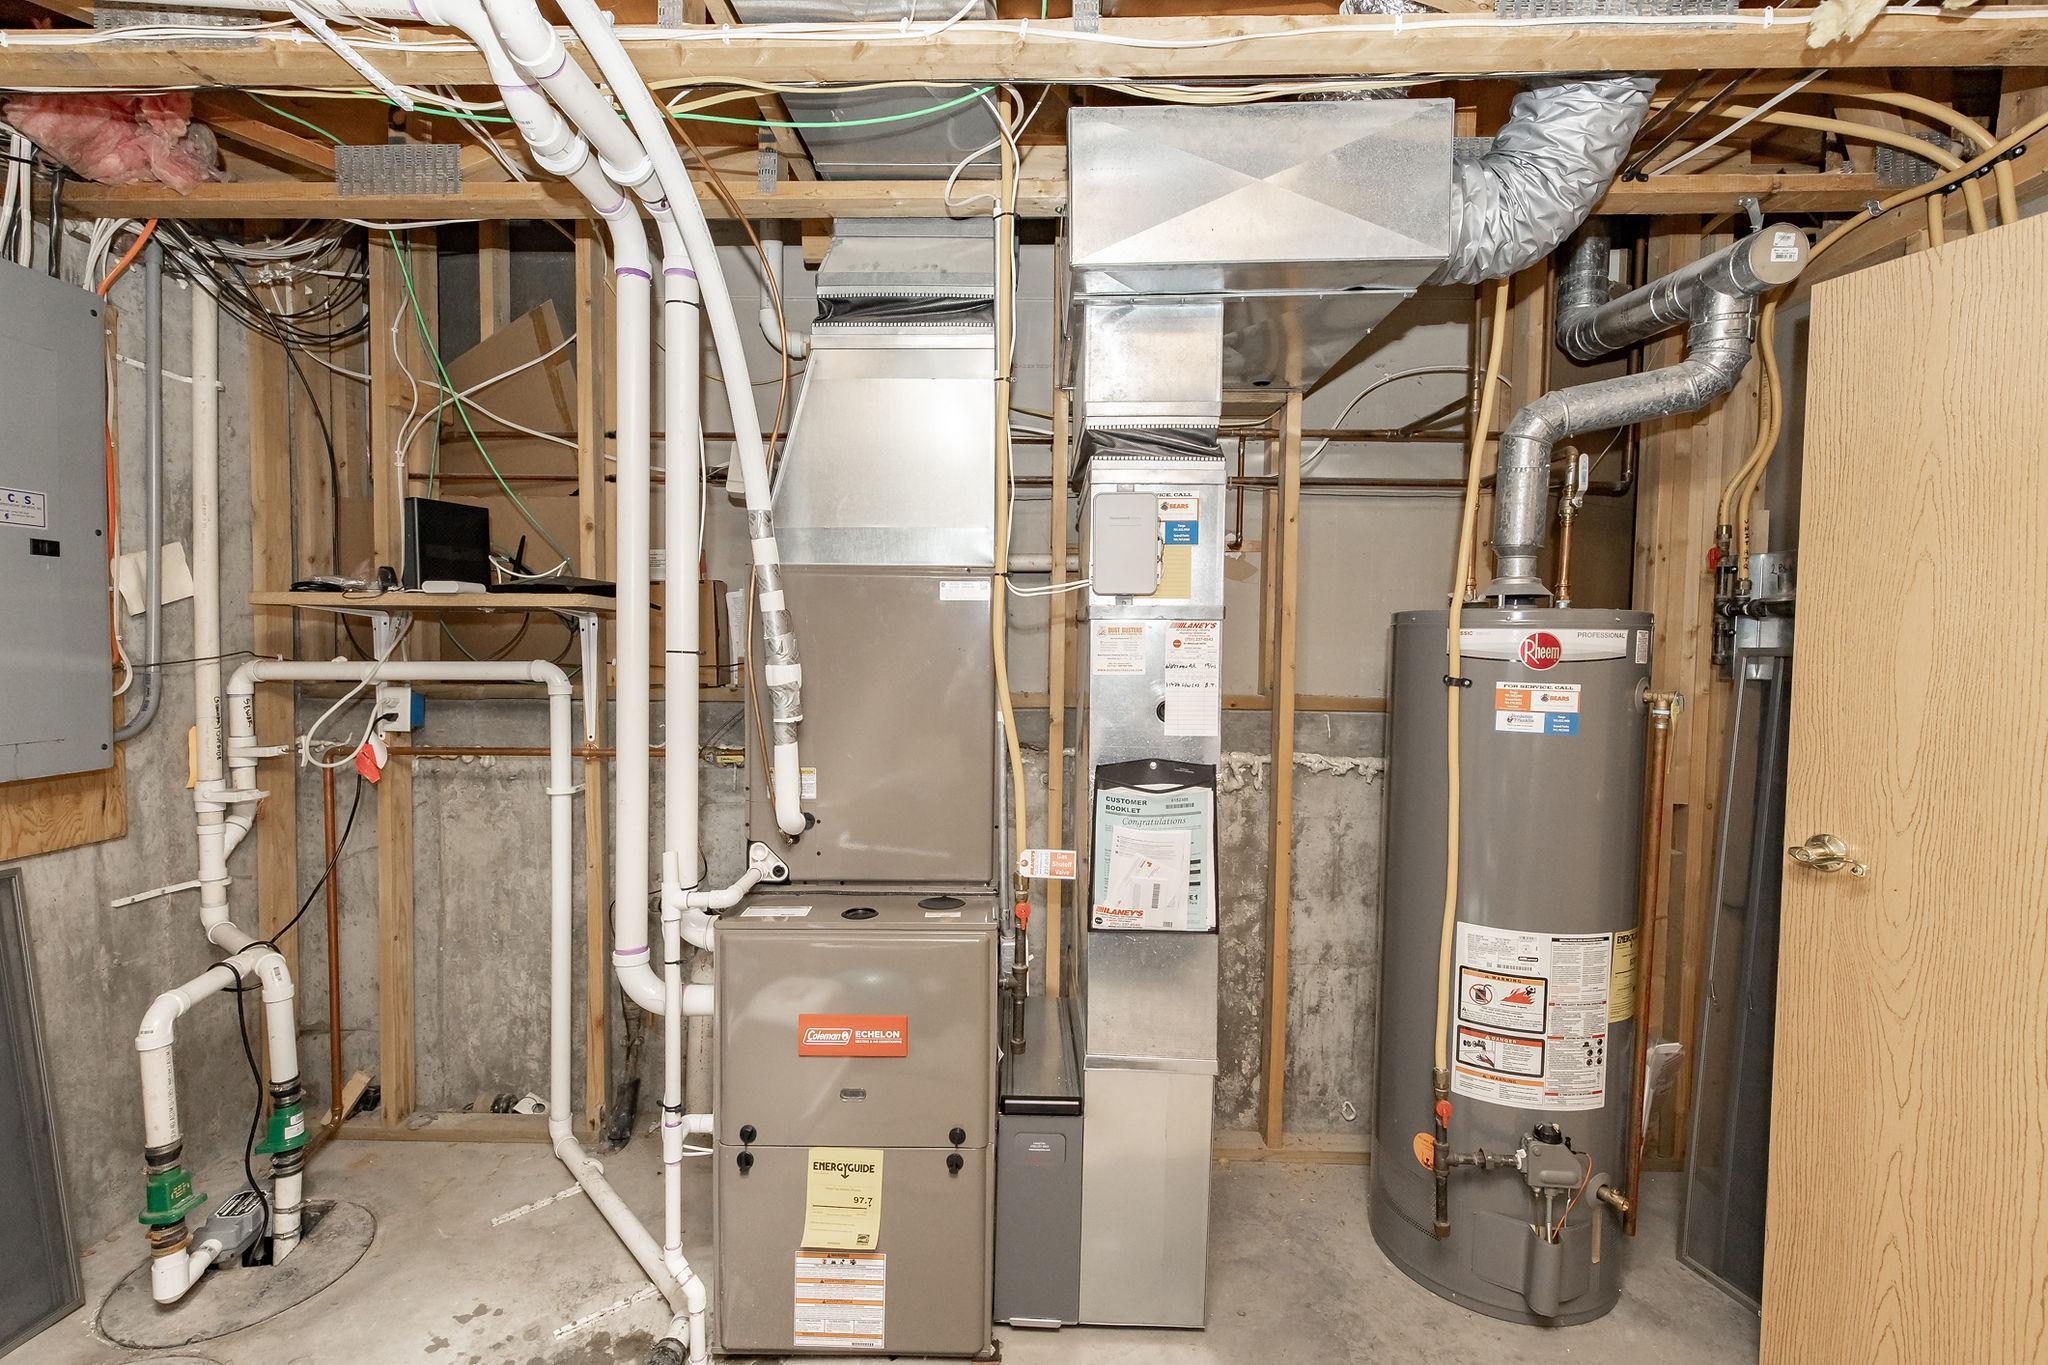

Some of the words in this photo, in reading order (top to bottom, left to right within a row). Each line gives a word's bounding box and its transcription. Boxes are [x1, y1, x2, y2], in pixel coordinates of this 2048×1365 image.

[1577, 631, 1626, 639] PROFESSIONAL
[1524, 633, 1560, 664] Rheem
[1105, 796, 1148, 806] CUSTOMER
[1105, 804, 1141, 814] BOOKLET
[1122, 816, 1187, 828] Congratulations
[1492, 975, 1522, 984] WARNING
[807, 1030, 841, 1041] Coleman
[855, 1030, 900, 1039] ECHELON
[1492, 1036, 1517, 1044] DANGER
[853, 1196, 873, 1205] 97.7
